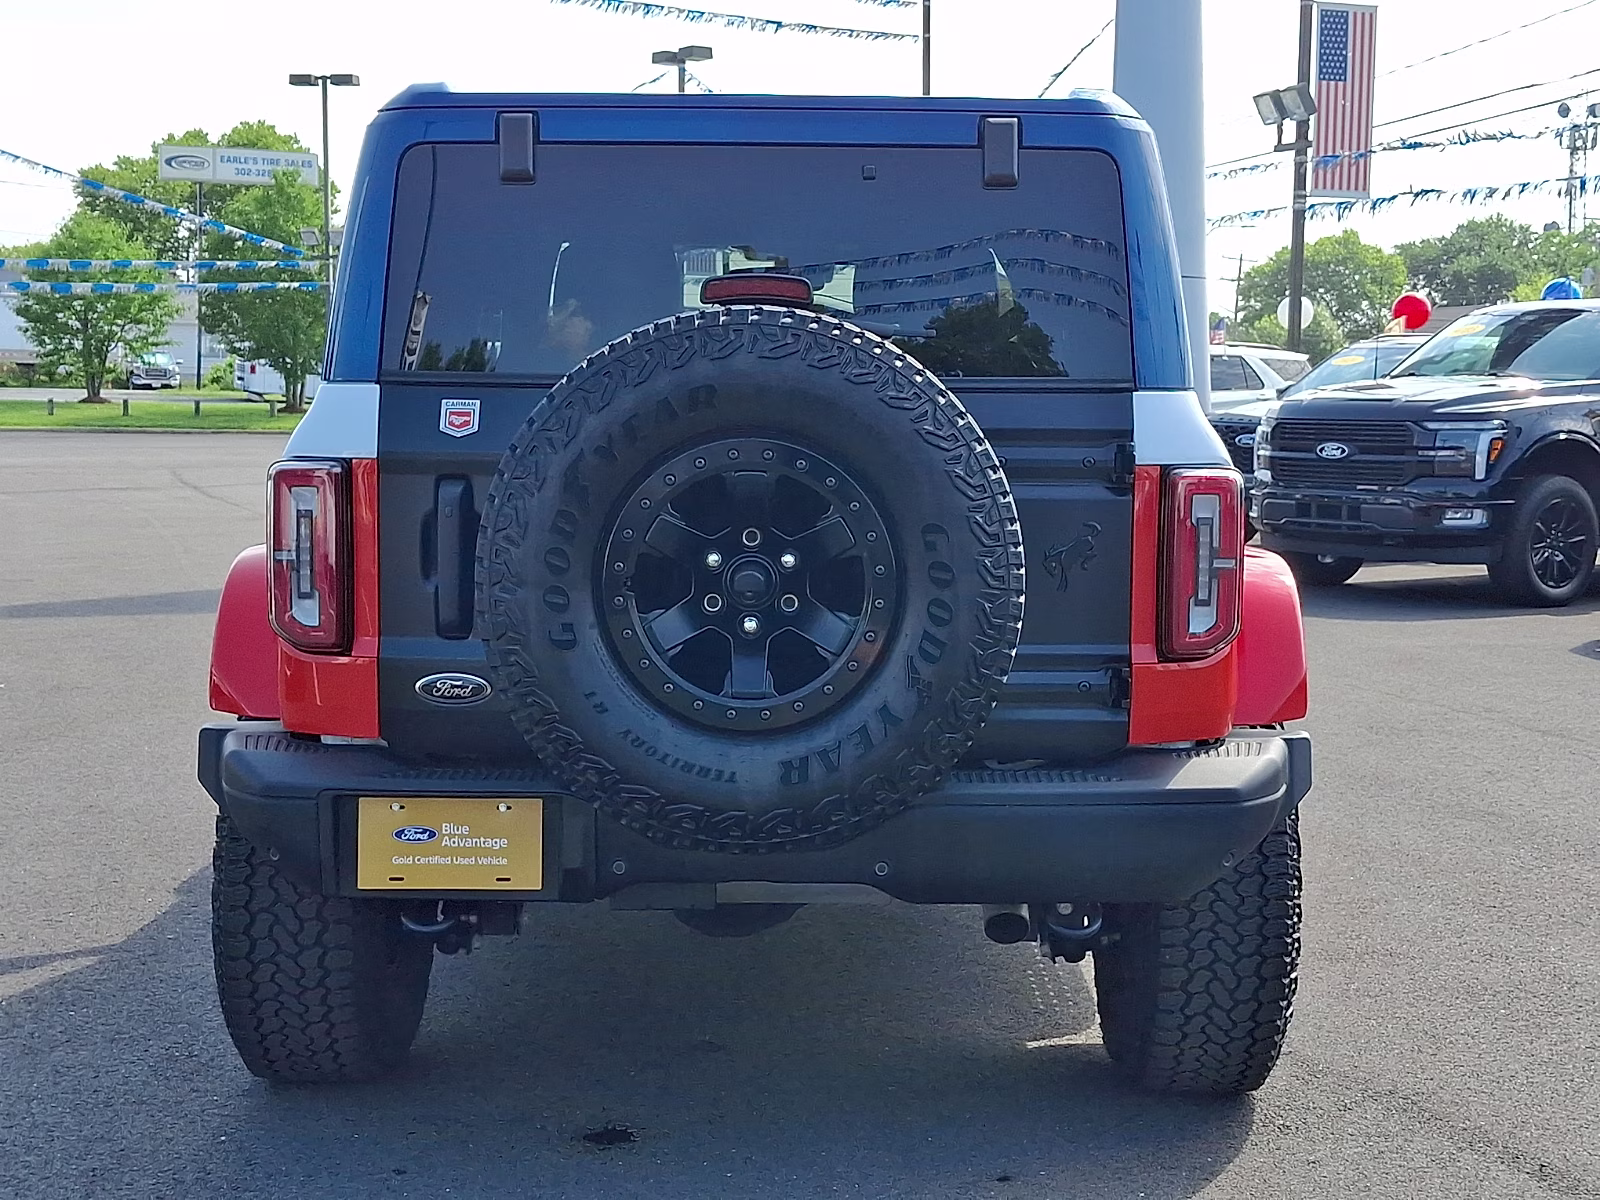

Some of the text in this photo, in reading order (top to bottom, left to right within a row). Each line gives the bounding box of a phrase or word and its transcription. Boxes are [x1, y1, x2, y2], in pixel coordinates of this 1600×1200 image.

[219, 154, 259, 166] EARLE'S
[261, 157, 282, 167] TIRE
[445, 400, 477, 408] CARMAN
[432, 679, 479, 697] Ford
[617, 728, 738, 784] TERRITORY
[401, 822, 470, 841] Ford Blue
[441, 835, 508, 849] Advantage
[391, 855, 508, 866] Gold Certified Used Vehicle
